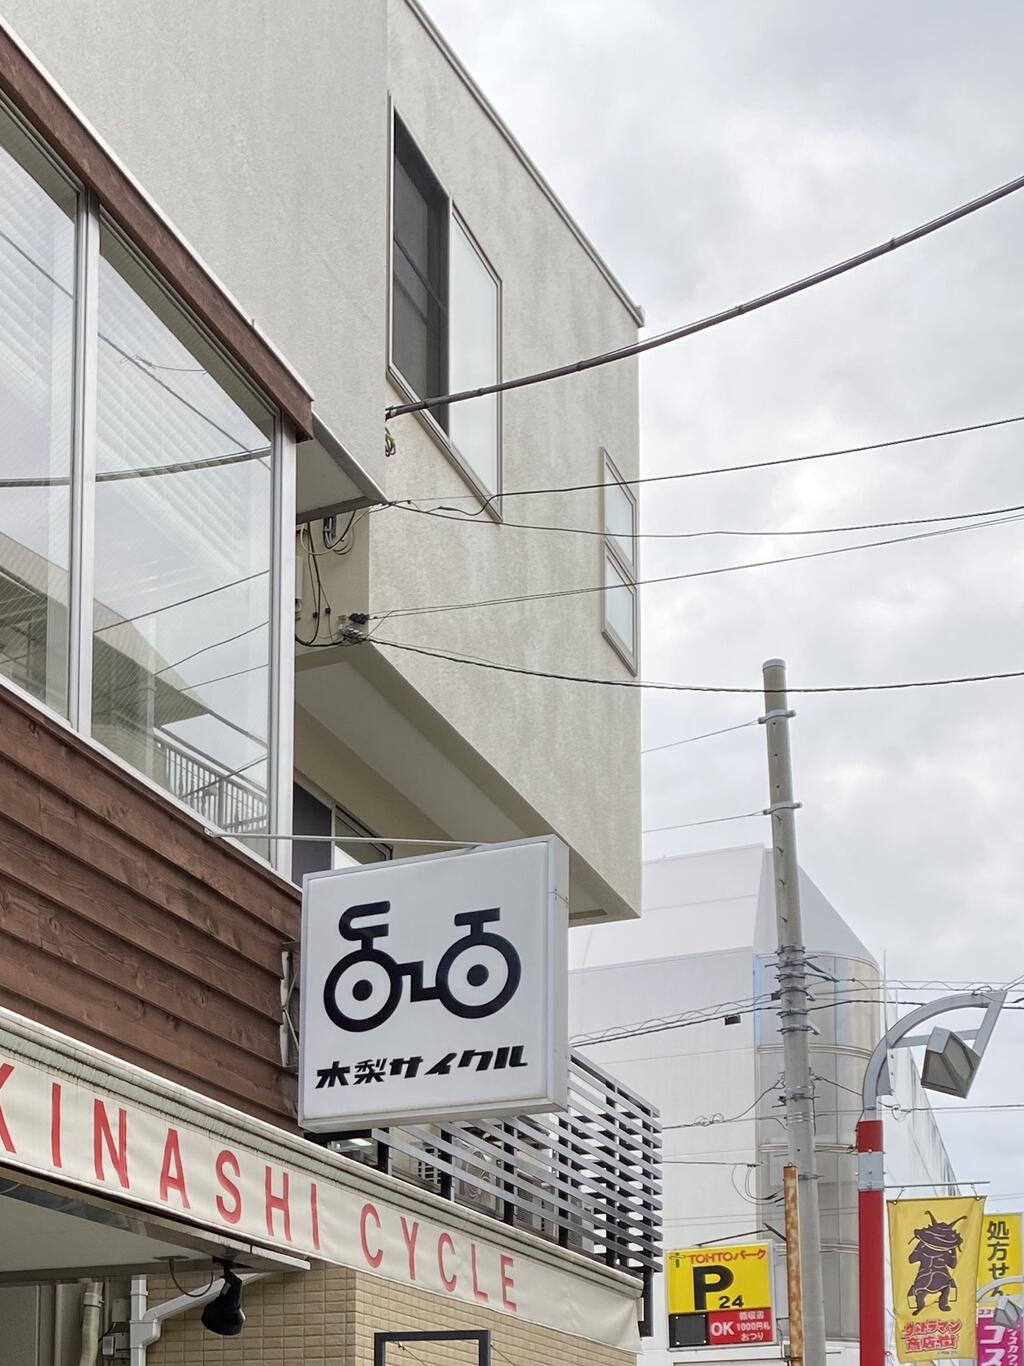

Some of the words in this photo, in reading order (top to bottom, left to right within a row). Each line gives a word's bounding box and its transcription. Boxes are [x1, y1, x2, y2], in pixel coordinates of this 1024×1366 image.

[316, 1045, 529, 1089] 木梨サイクル
[360, 1203, 519, 1312] CYCLE
[688, 1248, 766, 1264] TOHTOパーク
[693, 1265, 734, 1311] P
[719, 1295, 744, 1309] 24
[711, 1321, 734, 1336] OK
[736, 1321, 770, 1331] 1000円札
[741, 1332, 764, 1341] おつり
